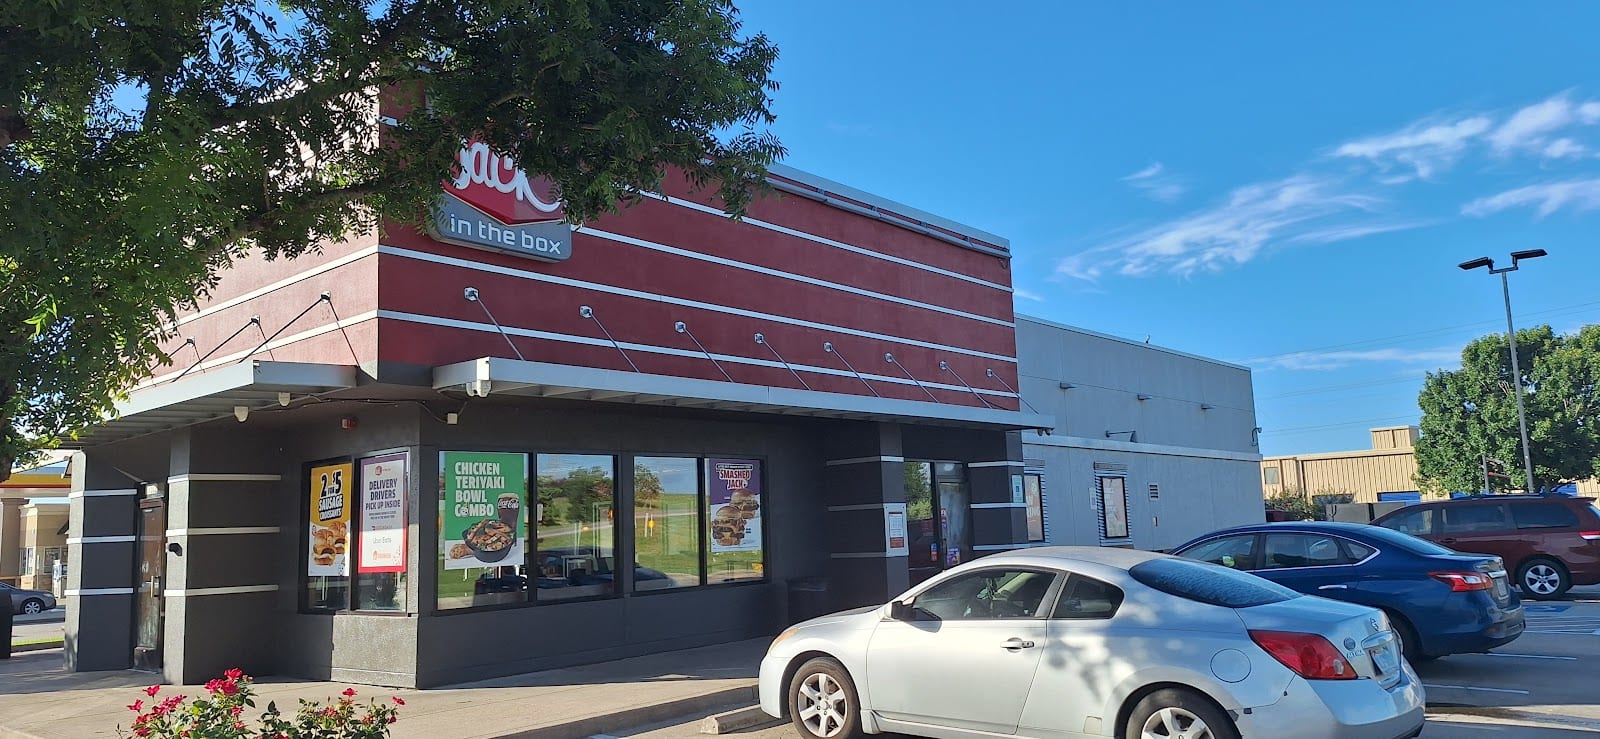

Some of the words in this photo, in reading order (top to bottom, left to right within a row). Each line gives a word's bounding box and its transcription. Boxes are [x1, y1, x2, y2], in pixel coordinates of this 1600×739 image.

[450, 213, 472, 236] in
[478, 220, 515, 246] the
[521, 230, 562, 255] box
[455, 462, 500, 475] CHICKEN
[720, 469, 750, 479] SMASHED
[321, 474, 327, 497] 2
[332, 471, 342, 494] $5
[369, 478, 398, 491] DELIVERY
[455, 476, 505, 489] TERIYAKI
[370, 489, 396, 501] DRIVERS
[455, 489, 487, 503] BOWL
[319, 495, 343, 510] SAUSAGE
[365, 502, 377, 511] PICK
[377, 501, 384, 509] UP
[384, 500, 401, 509] INSIDE
